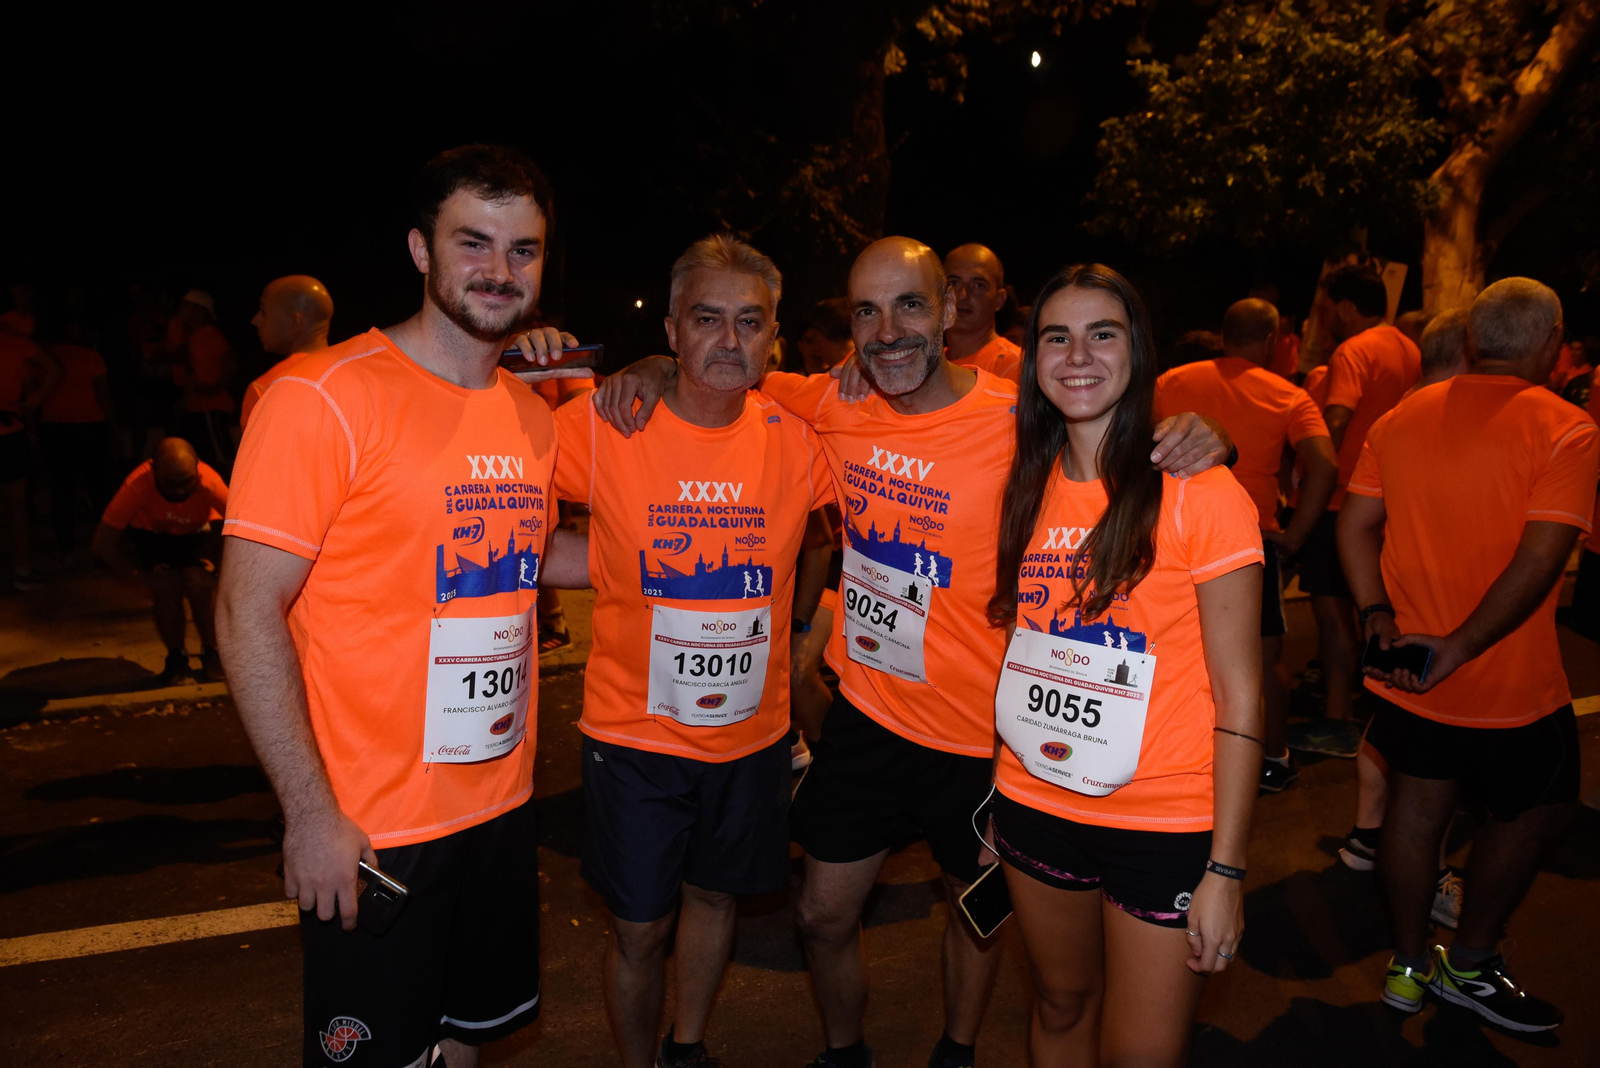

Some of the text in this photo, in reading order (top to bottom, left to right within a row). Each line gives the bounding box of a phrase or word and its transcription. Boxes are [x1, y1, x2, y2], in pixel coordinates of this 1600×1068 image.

[466, 455, 523, 479] XXXV
[866, 444, 935, 482] XXXV
[445, 483, 543, 496] CARRERA NOCTURNA
[677, 480, 743, 503] XXXV
[844, 460, 951, 502] CARRERA NOCTURNA
[847, 473, 948, 515] GUADALQUIVIR
[455, 496, 544, 512] GUADALQUIVIR
[648, 504, 765, 515] CARRERA NOCTURNA
[656, 515, 766, 528] GUADALQUIVIR
[846, 588, 899, 633] 9054
[674, 651, 752, 678] 13010
[462, 657, 528, 700] 13014
[672, 679, 707, 688] FRANCISCO
[1020, 666, 1039, 676] CARRERA
[1039, 670, 1064, 682] NOCTURNA
[1065, 677, 1074, 685] DEL
[1074, 680, 1114, 694] GUADALQUIVIR
[1126, 690, 1140, 698] 2023
[443, 705, 487, 714] FRANCISCO
[486, 700, 509, 712] ALVARO
[1027, 683, 1103, 728] 9055
[1016, 715, 1108, 745] CARIDAD ZUMÁRRAGA BRUNA
